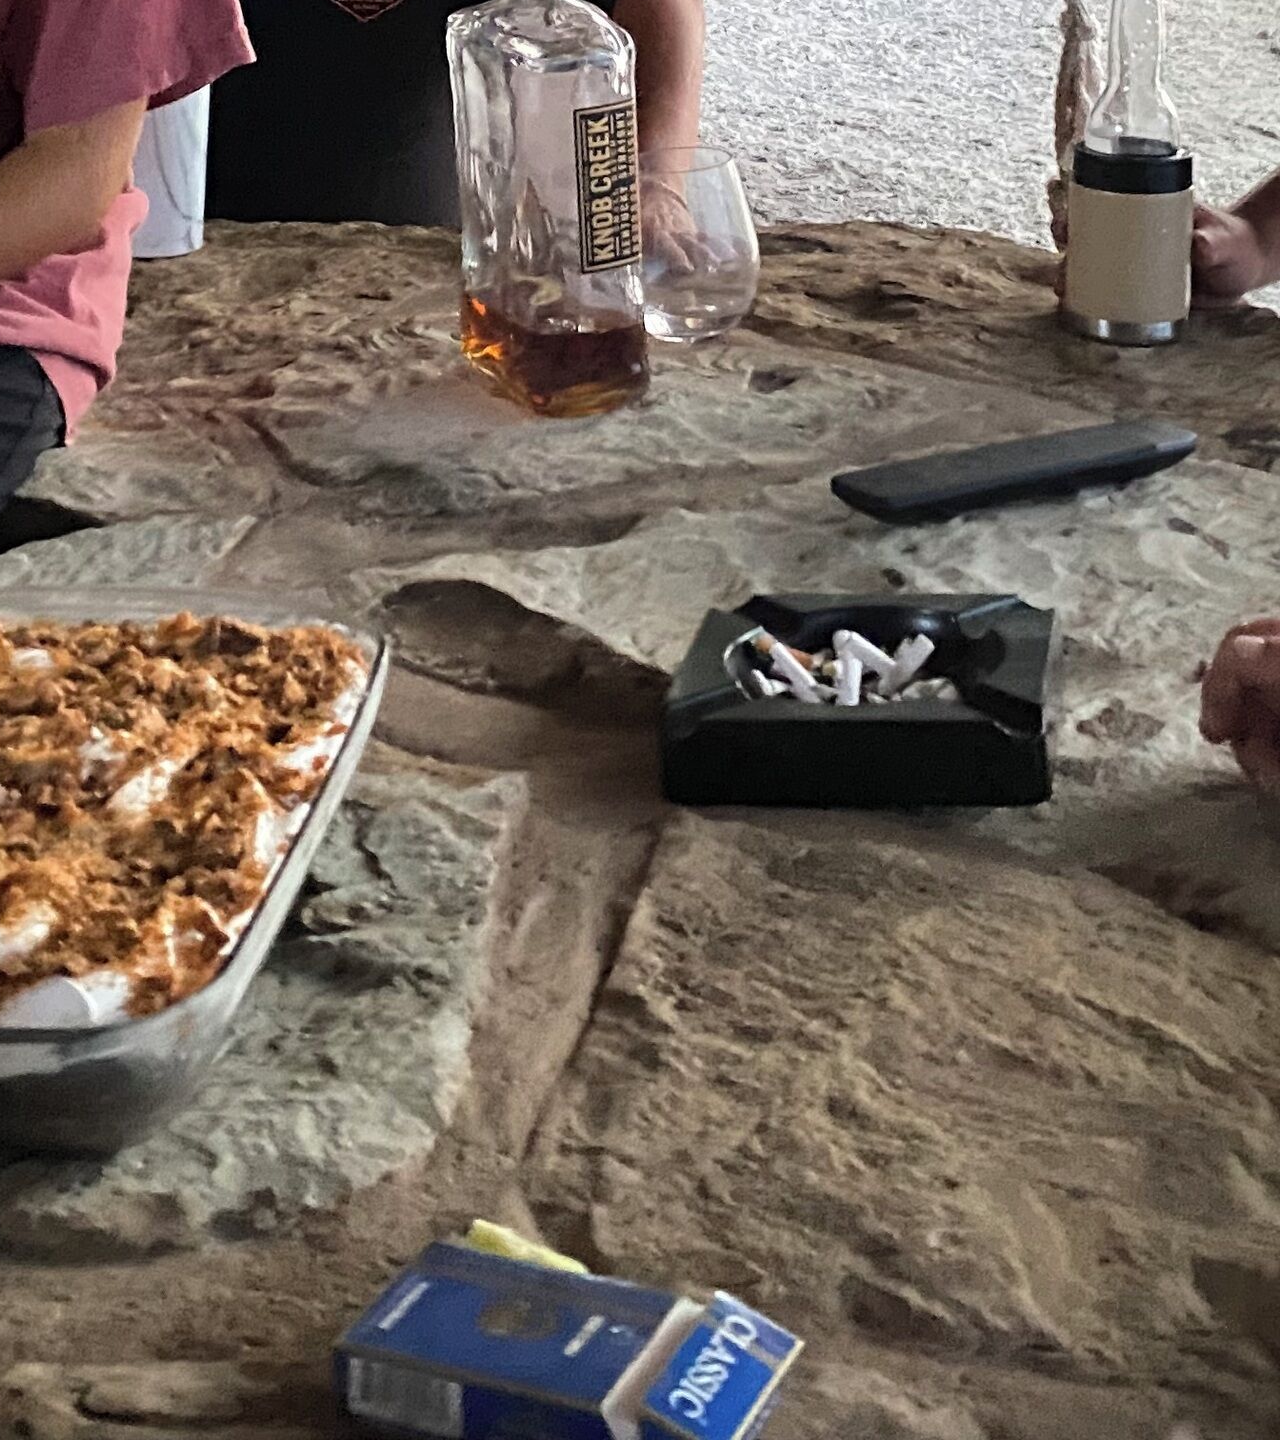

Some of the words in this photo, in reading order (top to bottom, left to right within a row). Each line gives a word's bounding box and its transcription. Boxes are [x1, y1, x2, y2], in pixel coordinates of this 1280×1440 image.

[587, 116, 615, 194] CREEK
[591, 195, 616, 260] KNOB
[669, 1315, 757, 1419] CLASSIC
